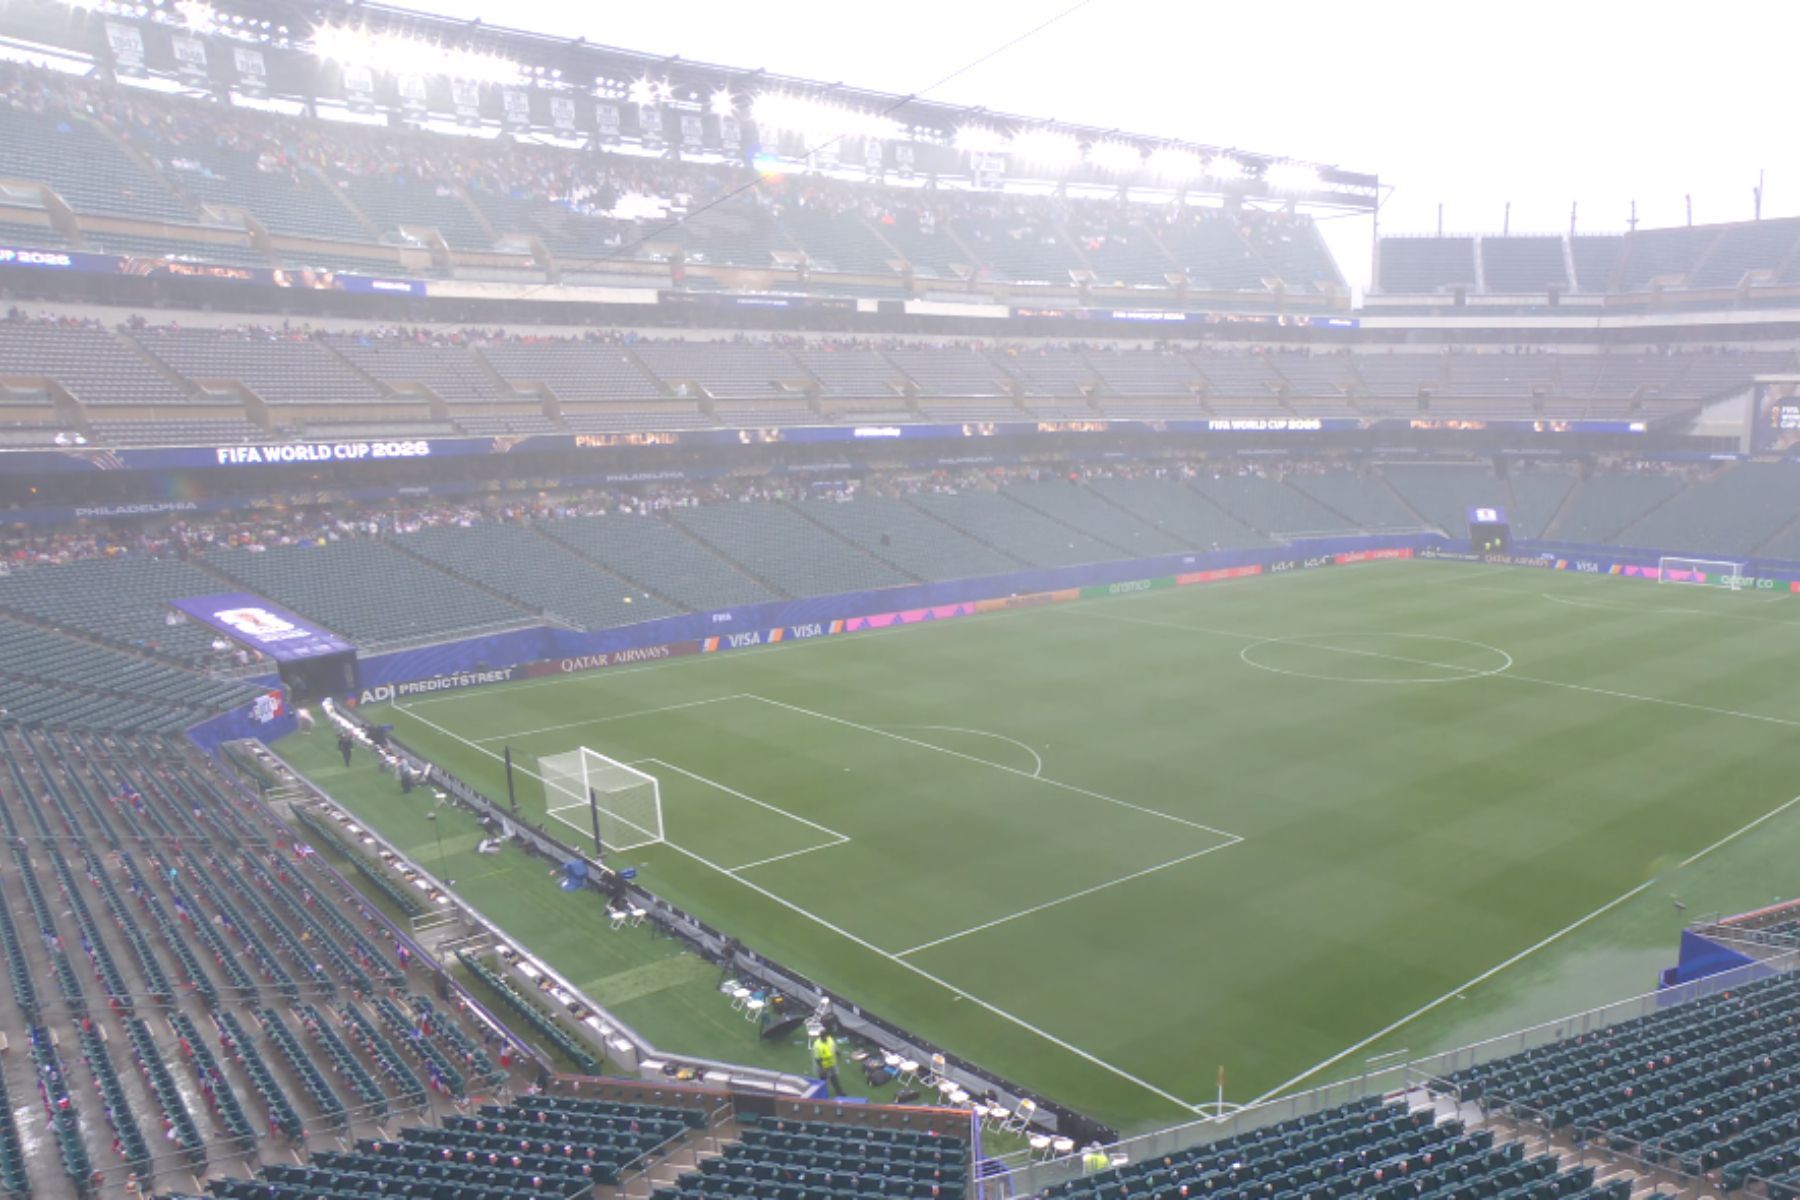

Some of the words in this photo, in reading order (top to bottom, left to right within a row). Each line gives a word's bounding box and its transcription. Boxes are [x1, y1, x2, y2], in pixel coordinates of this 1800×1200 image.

[17, 251, 72, 266] 2026
[1208, 420, 1230, 431] FIFA
[1232, 420, 1267, 431] WORLD
[1269, 420, 1287, 430] CUP
[1289, 419, 1322, 430] 2026
[216, 447, 261, 465] FIFA
[262, 445, 330, 462] WORLD
[334, 444, 369, 459] CUP
[371, 440, 430, 457] 2026
[75, 501, 198, 517] PHILADELPHIA
[1576, 560, 1600, 573] VISA
[1109, 578, 1151, 595] aramco
[729, 631, 760, 649] VISA
[792, 623, 822, 640] VISA
[561, 654, 608, 673] QATAR
[613, 643, 669, 664] AIRWAYS
[399, 668, 513, 695] PREDICTSTREET
